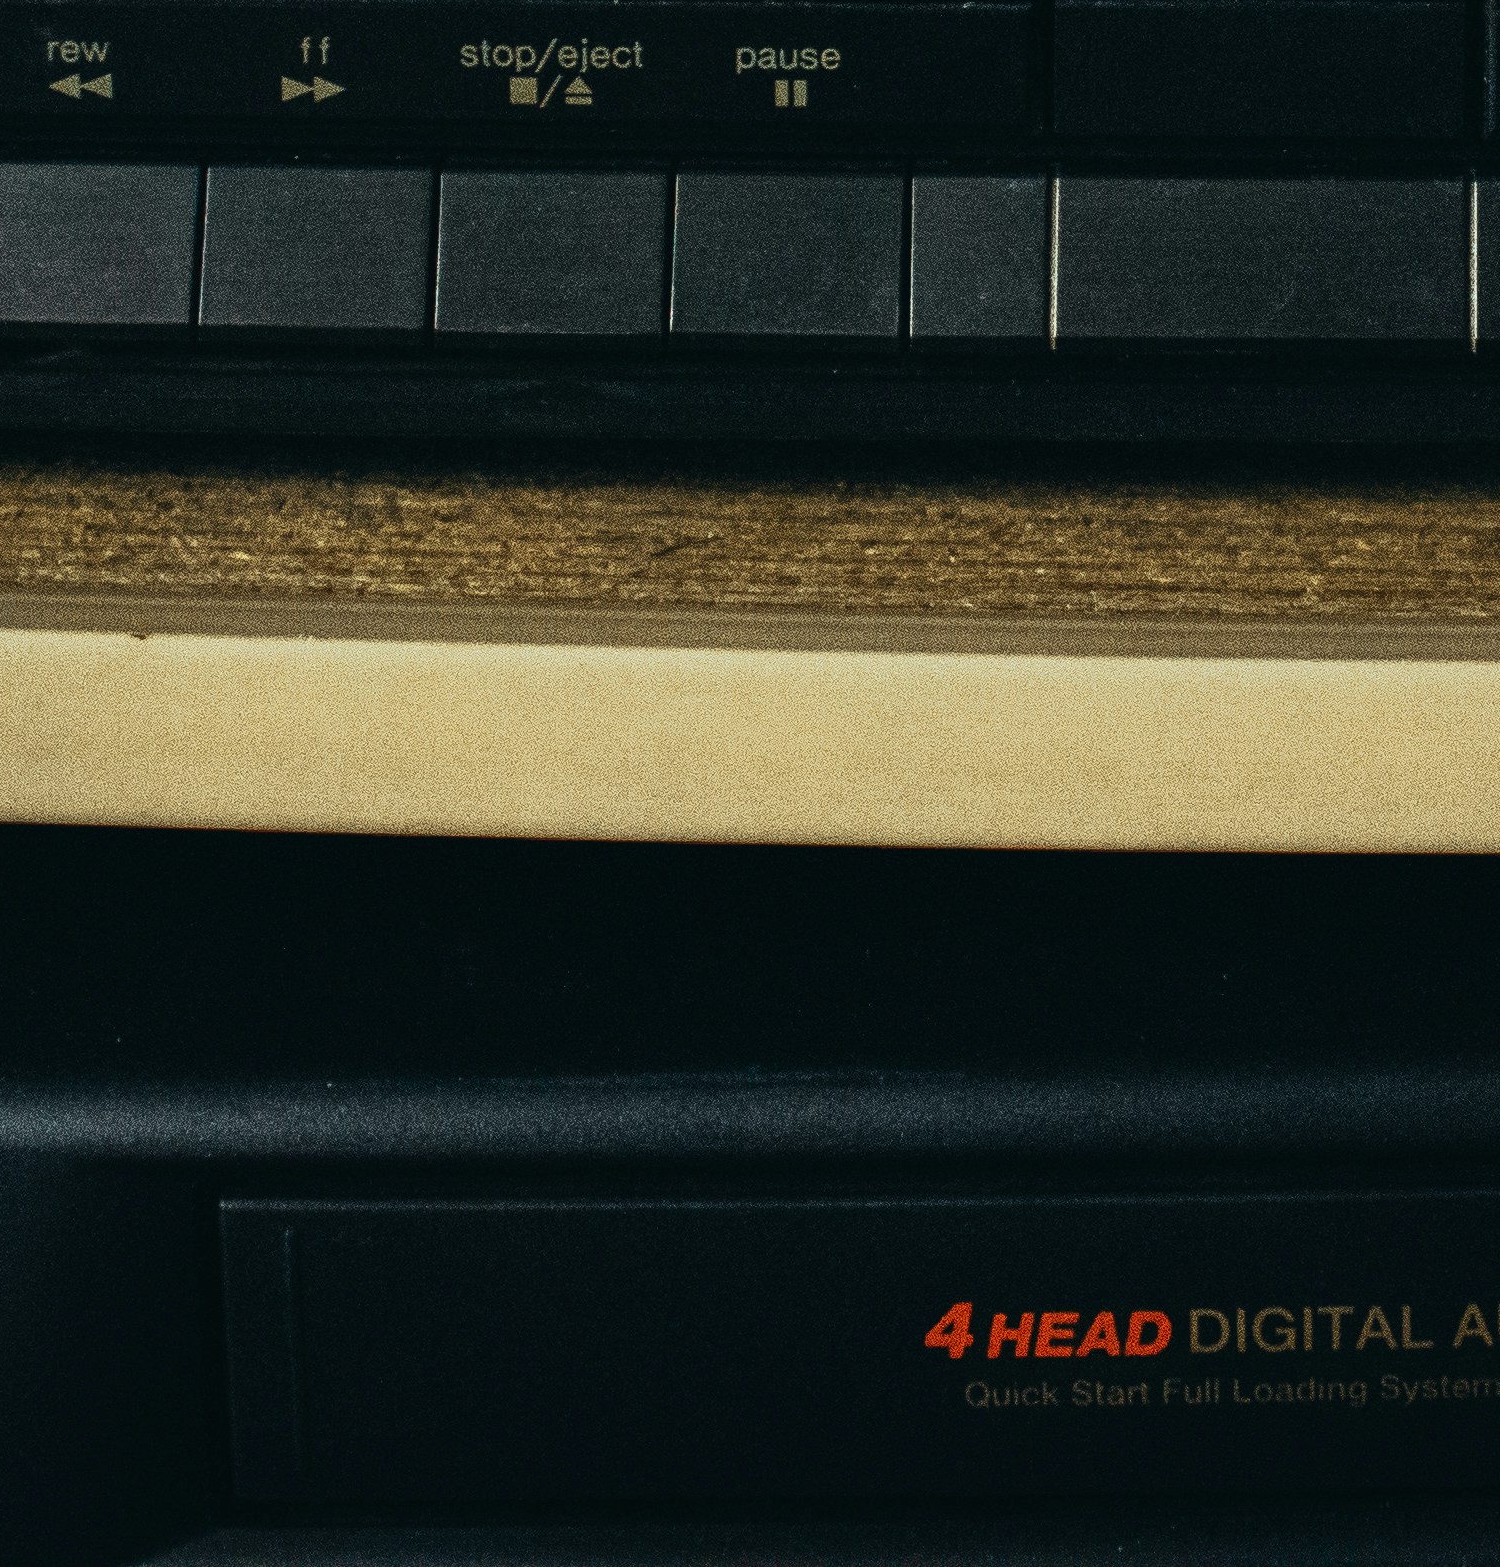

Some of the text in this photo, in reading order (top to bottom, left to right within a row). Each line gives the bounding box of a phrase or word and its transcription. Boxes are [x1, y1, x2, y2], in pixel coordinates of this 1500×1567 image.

[47, 40, 108, 63] rew
[301, 36, 329, 64] ff
[461, 38, 643, 74] stop/eject
[736, 47, 841, 73] pause
[925, 1303, 973, 1358] 4
[988, 1312, 1171, 1357] HEAD
[1190, 1306, 1432, 1353] DIGITAL
[965, 1381, 1057, 1407] Quick
[1072, 1380, 1148, 1405] Start
[1162, 1378, 1220, 1404] Full
[1233, 1377, 1368, 1407] Loading
[1380, 1374, 1500, 1404] System
